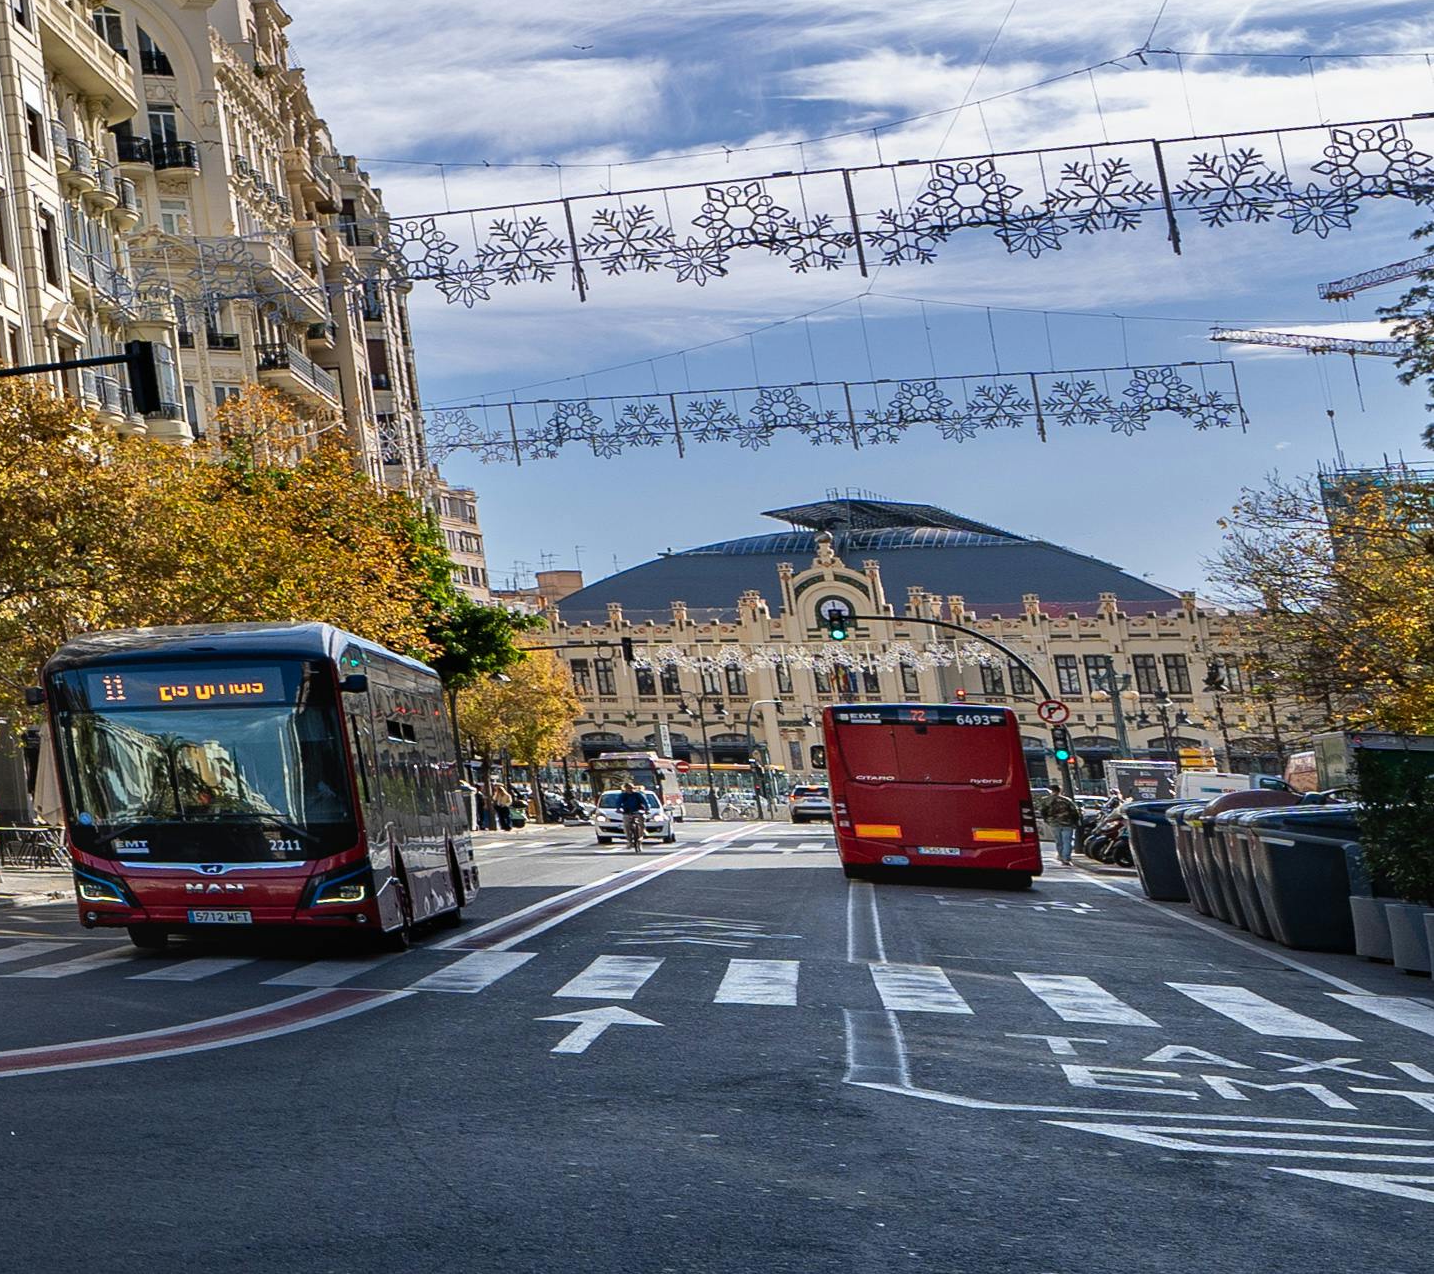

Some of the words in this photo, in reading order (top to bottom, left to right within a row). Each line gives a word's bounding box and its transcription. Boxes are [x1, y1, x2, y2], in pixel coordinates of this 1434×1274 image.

[102, 674, 126, 701] 11
[910, 710, 926, 722] 72
[956, 715, 991, 725] 6493
[115, 840, 148, 848] EMT
[268, 840, 302, 851] 2211
[185, 883, 244, 893] MAN
[195, 912, 225, 922] 5712
[228, 912, 249, 922] MFT
